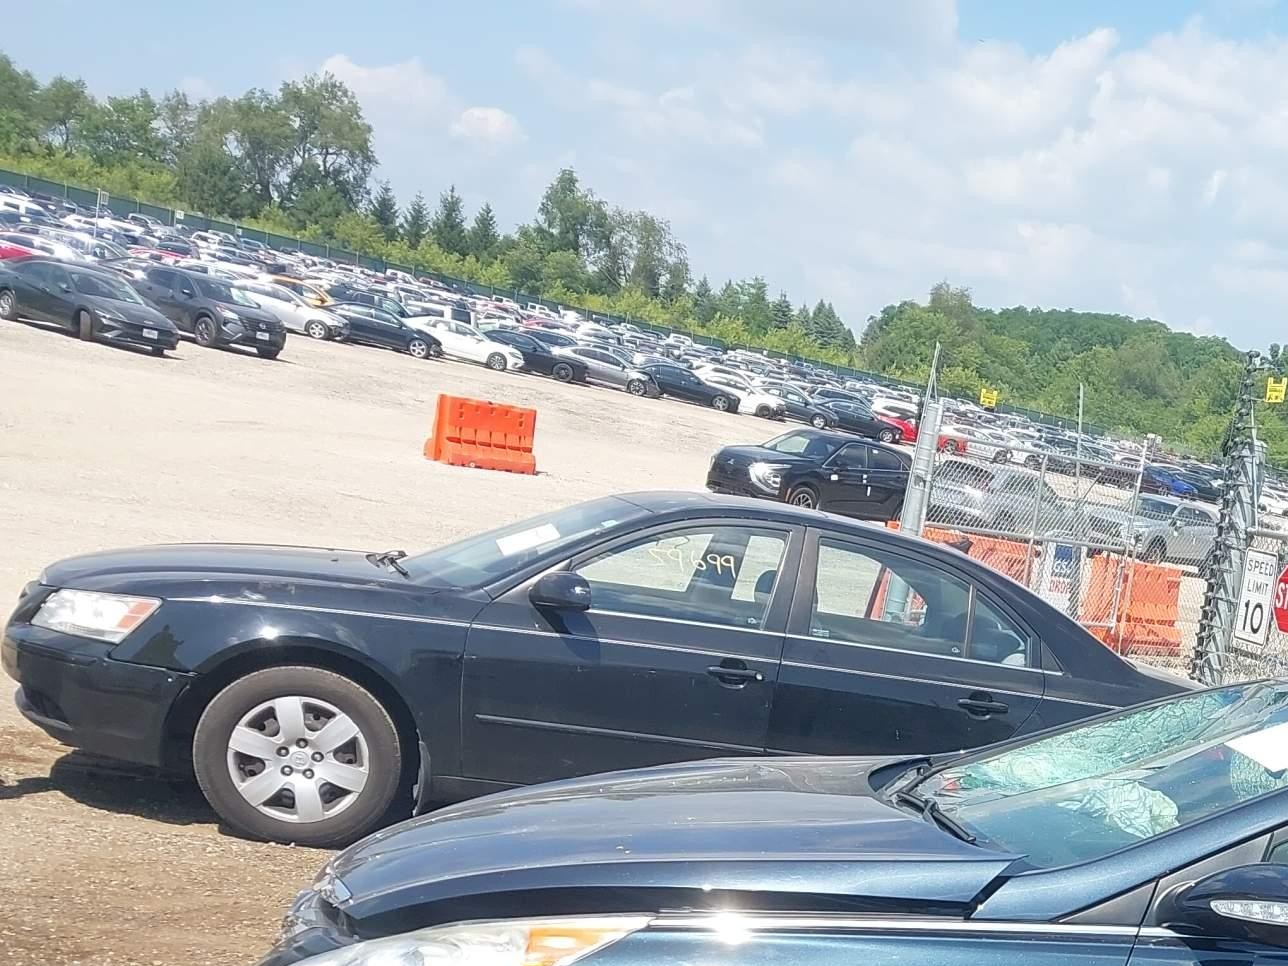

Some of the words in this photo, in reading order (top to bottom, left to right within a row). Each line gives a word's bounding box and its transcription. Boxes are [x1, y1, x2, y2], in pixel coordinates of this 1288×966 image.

[1247, 558, 1274, 577] SPEED
[1247, 579, 1269, 596] LIMIT
[1242, 600, 1264, 634] 10
